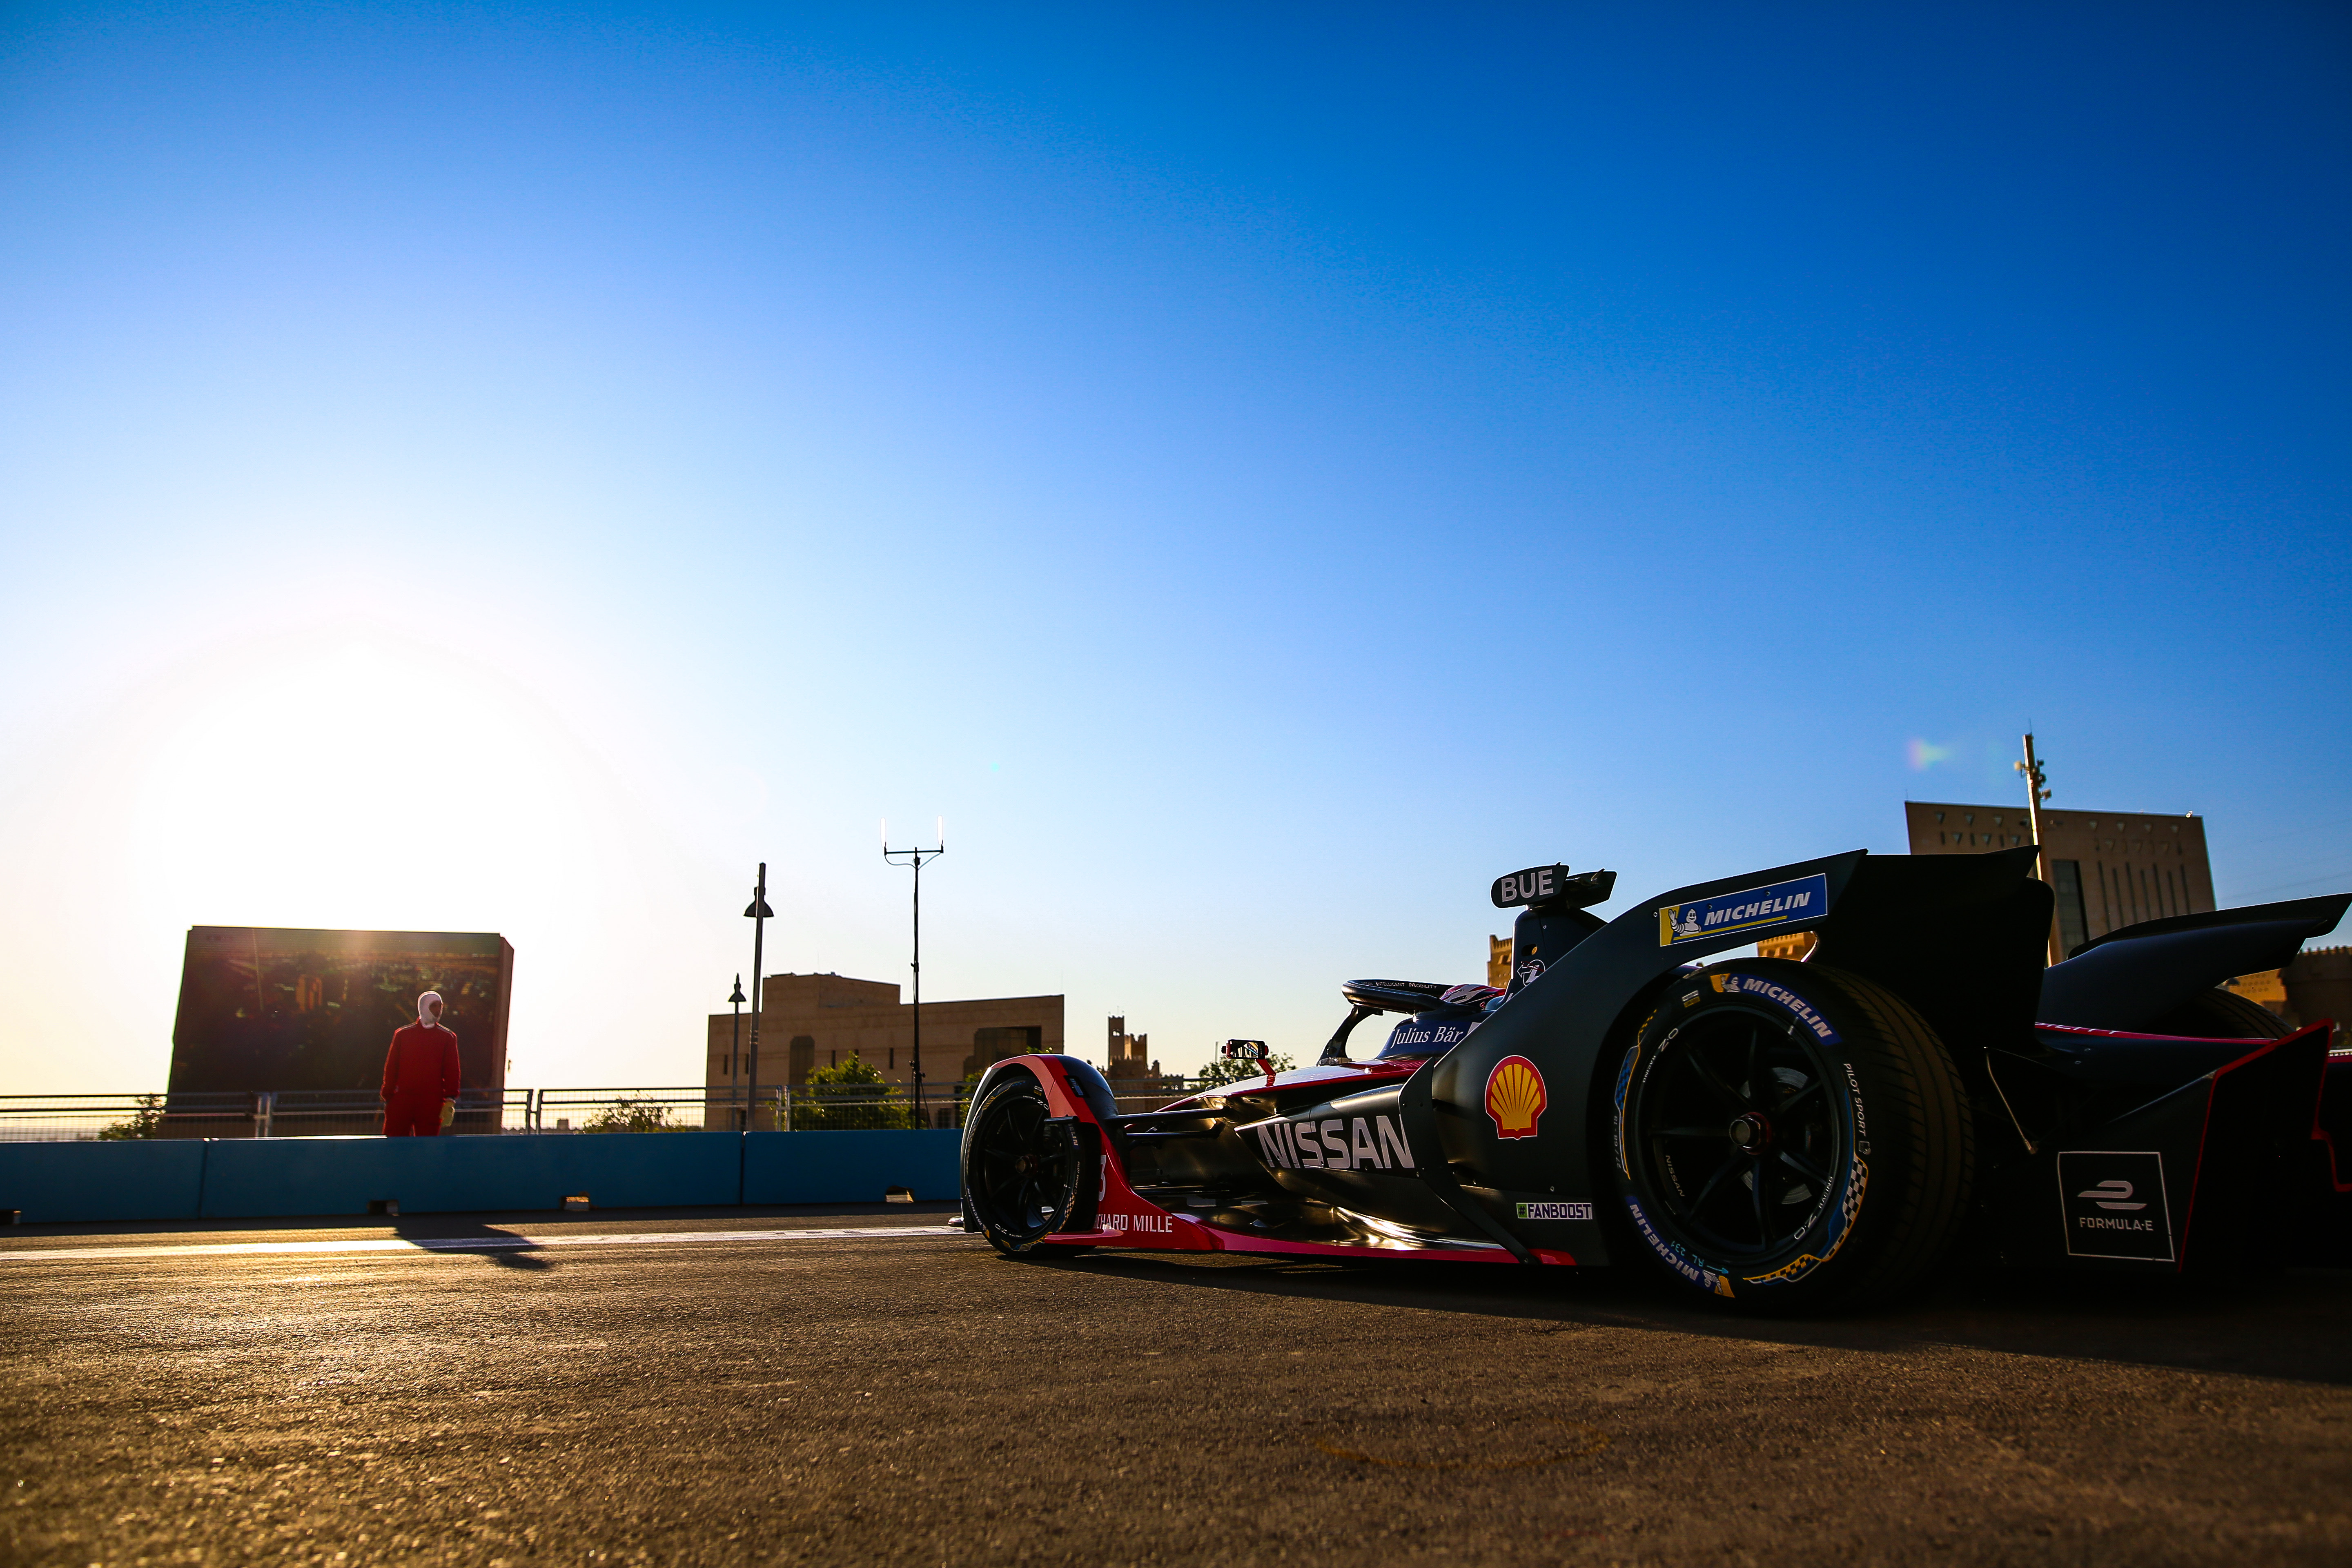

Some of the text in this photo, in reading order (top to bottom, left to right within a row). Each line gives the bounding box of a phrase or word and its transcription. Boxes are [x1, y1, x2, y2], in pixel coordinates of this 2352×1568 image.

[1500, 868, 1554, 902] BUE
[1704, 891, 1811, 926] MICHELIN
[1743, 978, 1833, 1038] MICHELIN
[1390, 1027, 1463, 1049] Julius Bär
[1842, 1063, 1866, 1137] PILOT SPORT
[1257, 1115, 1414, 1169] NISSAN
[1665, 1155, 1685, 1197] NISSAN
[967, 1187, 982, 1225] MICHELIN
[1134, 1215, 1173, 1232] MILLE
[1519, 1203, 1591, 1218] #FANBOOST
[1630, 1204, 1699, 1281] MICHELIN
